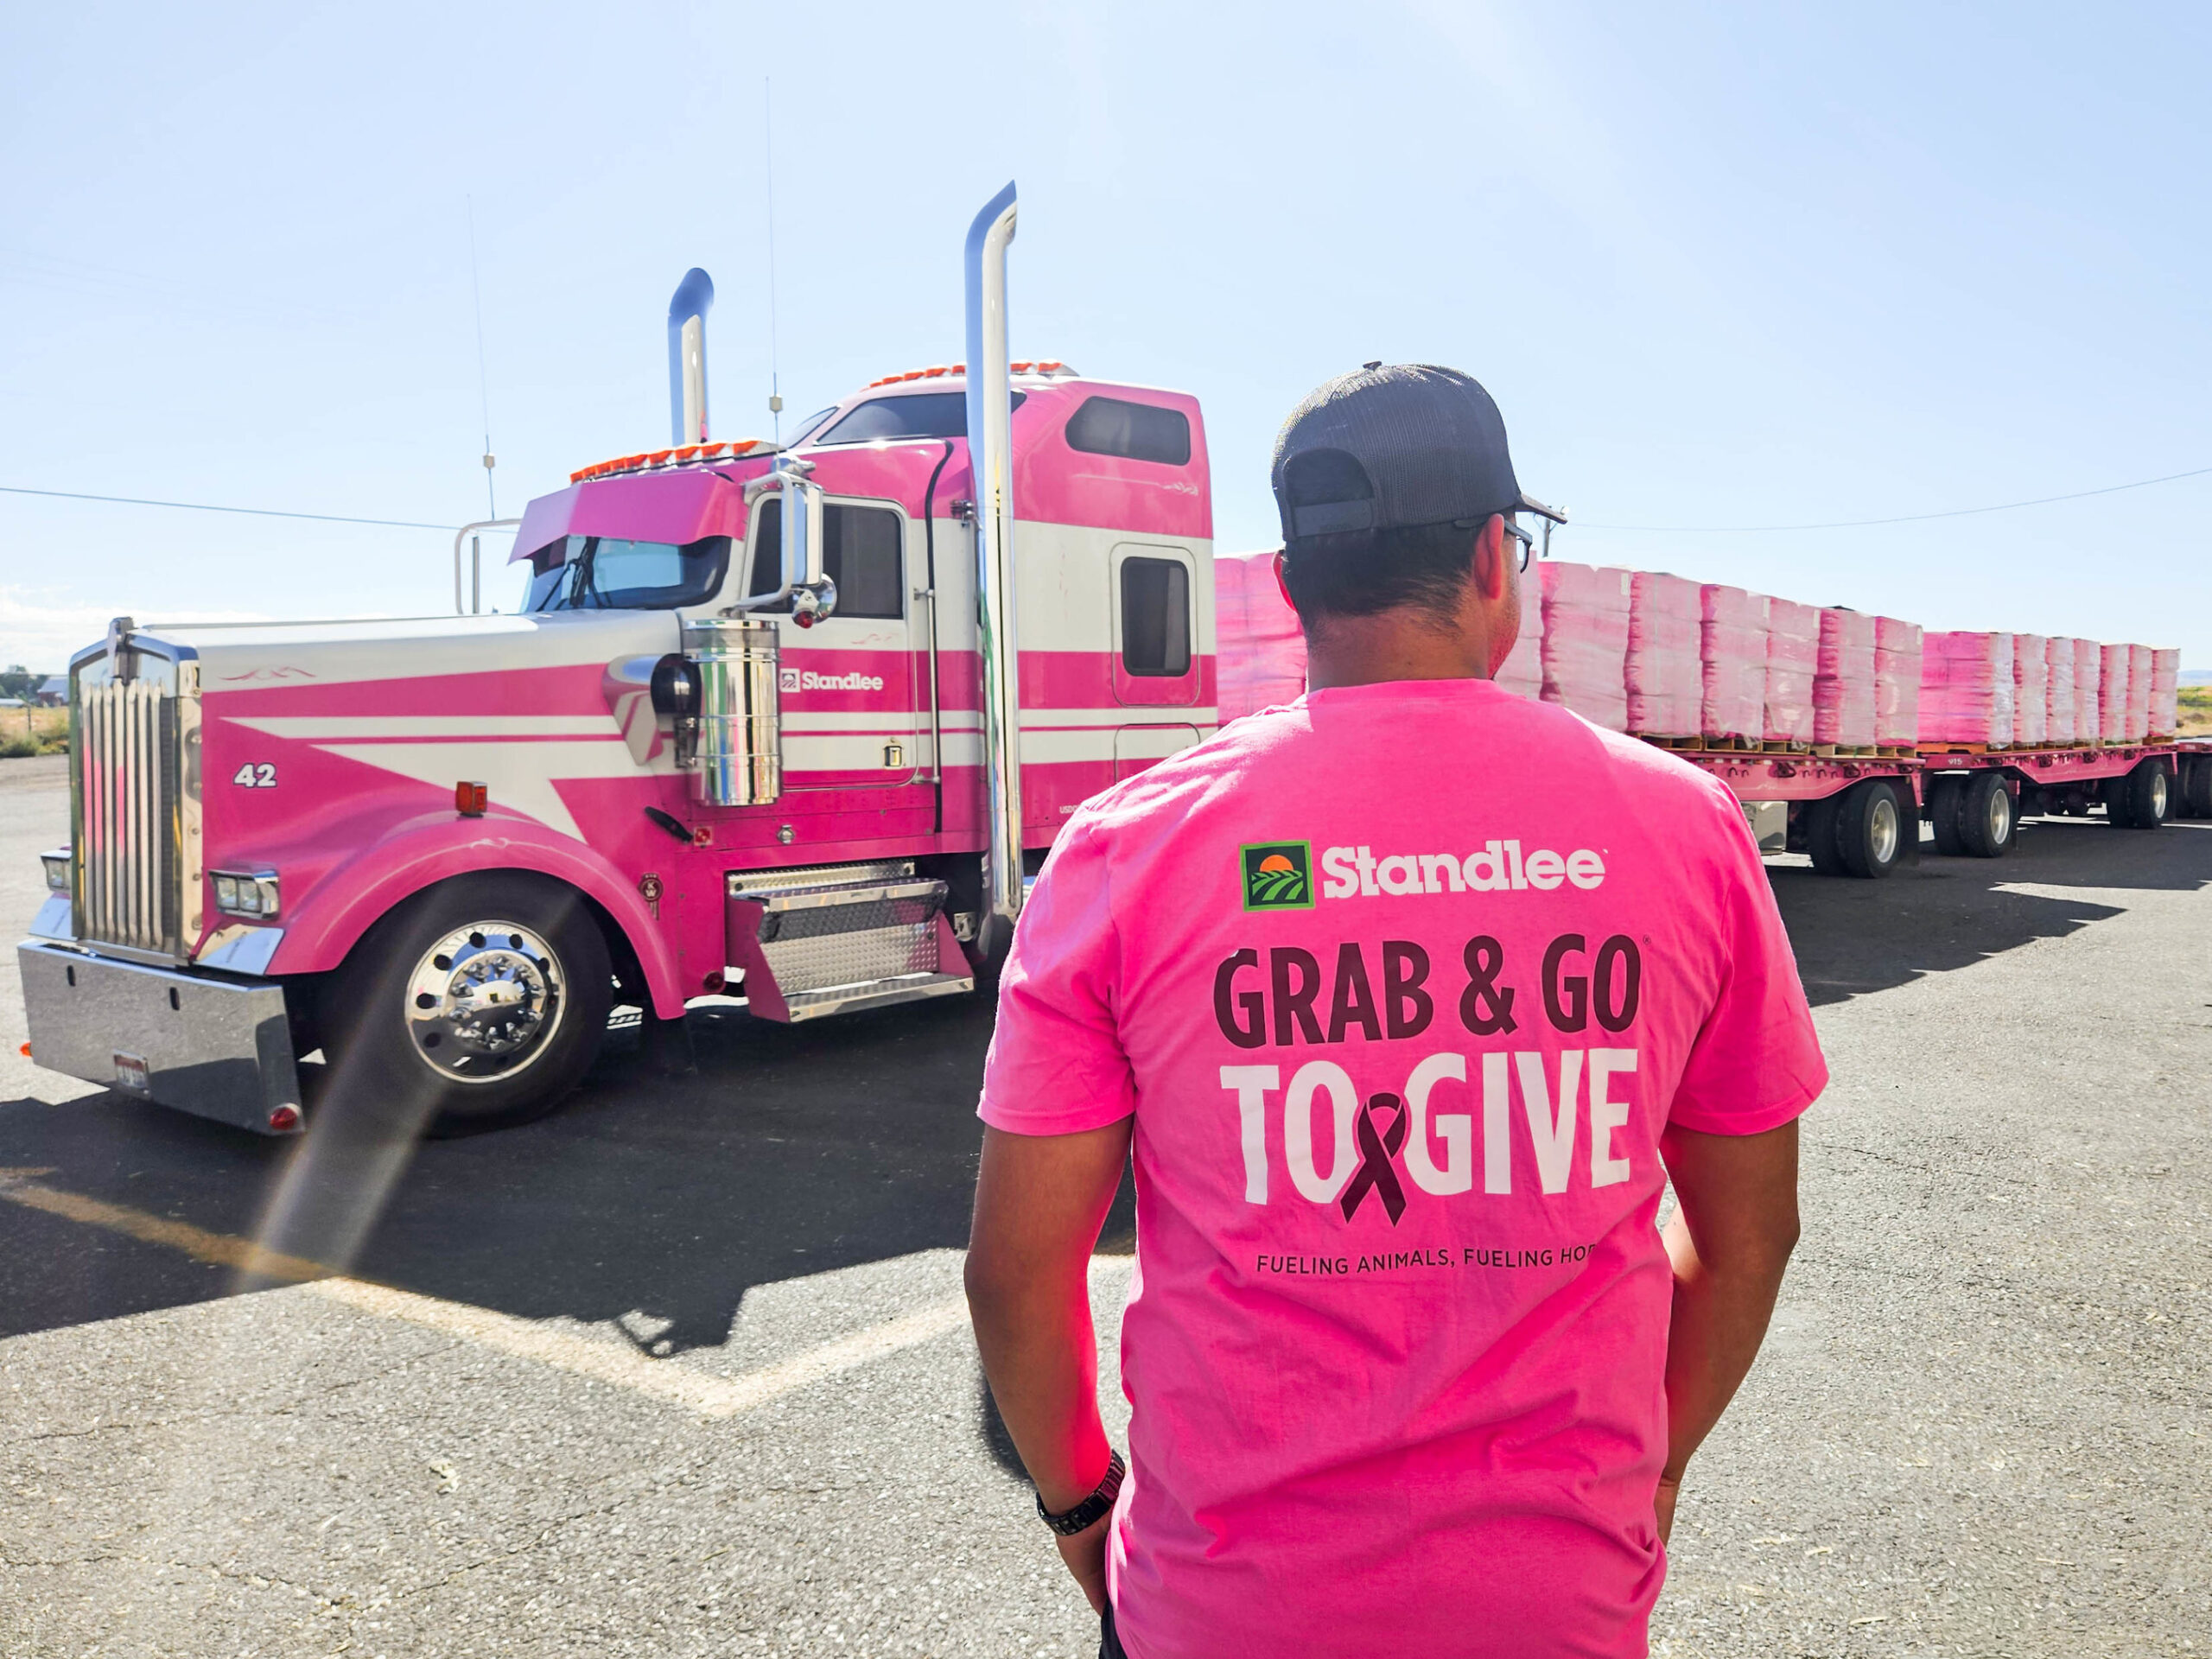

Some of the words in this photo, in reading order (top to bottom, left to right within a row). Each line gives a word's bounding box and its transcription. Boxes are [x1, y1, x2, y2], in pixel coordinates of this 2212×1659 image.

[802, 671, 883, 690] Standlee
[233, 763, 277, 788] 42
[1322, 840, 1605, 899] Standlee
[1214, 941, 1433, 1048] GRAB
[1459, 935, 1518, 1036] &
[1219, 1060, 1360, 1205] TO
[1402, 1047, 1638, 1196] GIVE
[1257, 1255, 1349, 1274] FUELING
[1357, 1249, 1455, 1274] ANIMALS,
[1464, 1248, 1553, 1268] FUELING
